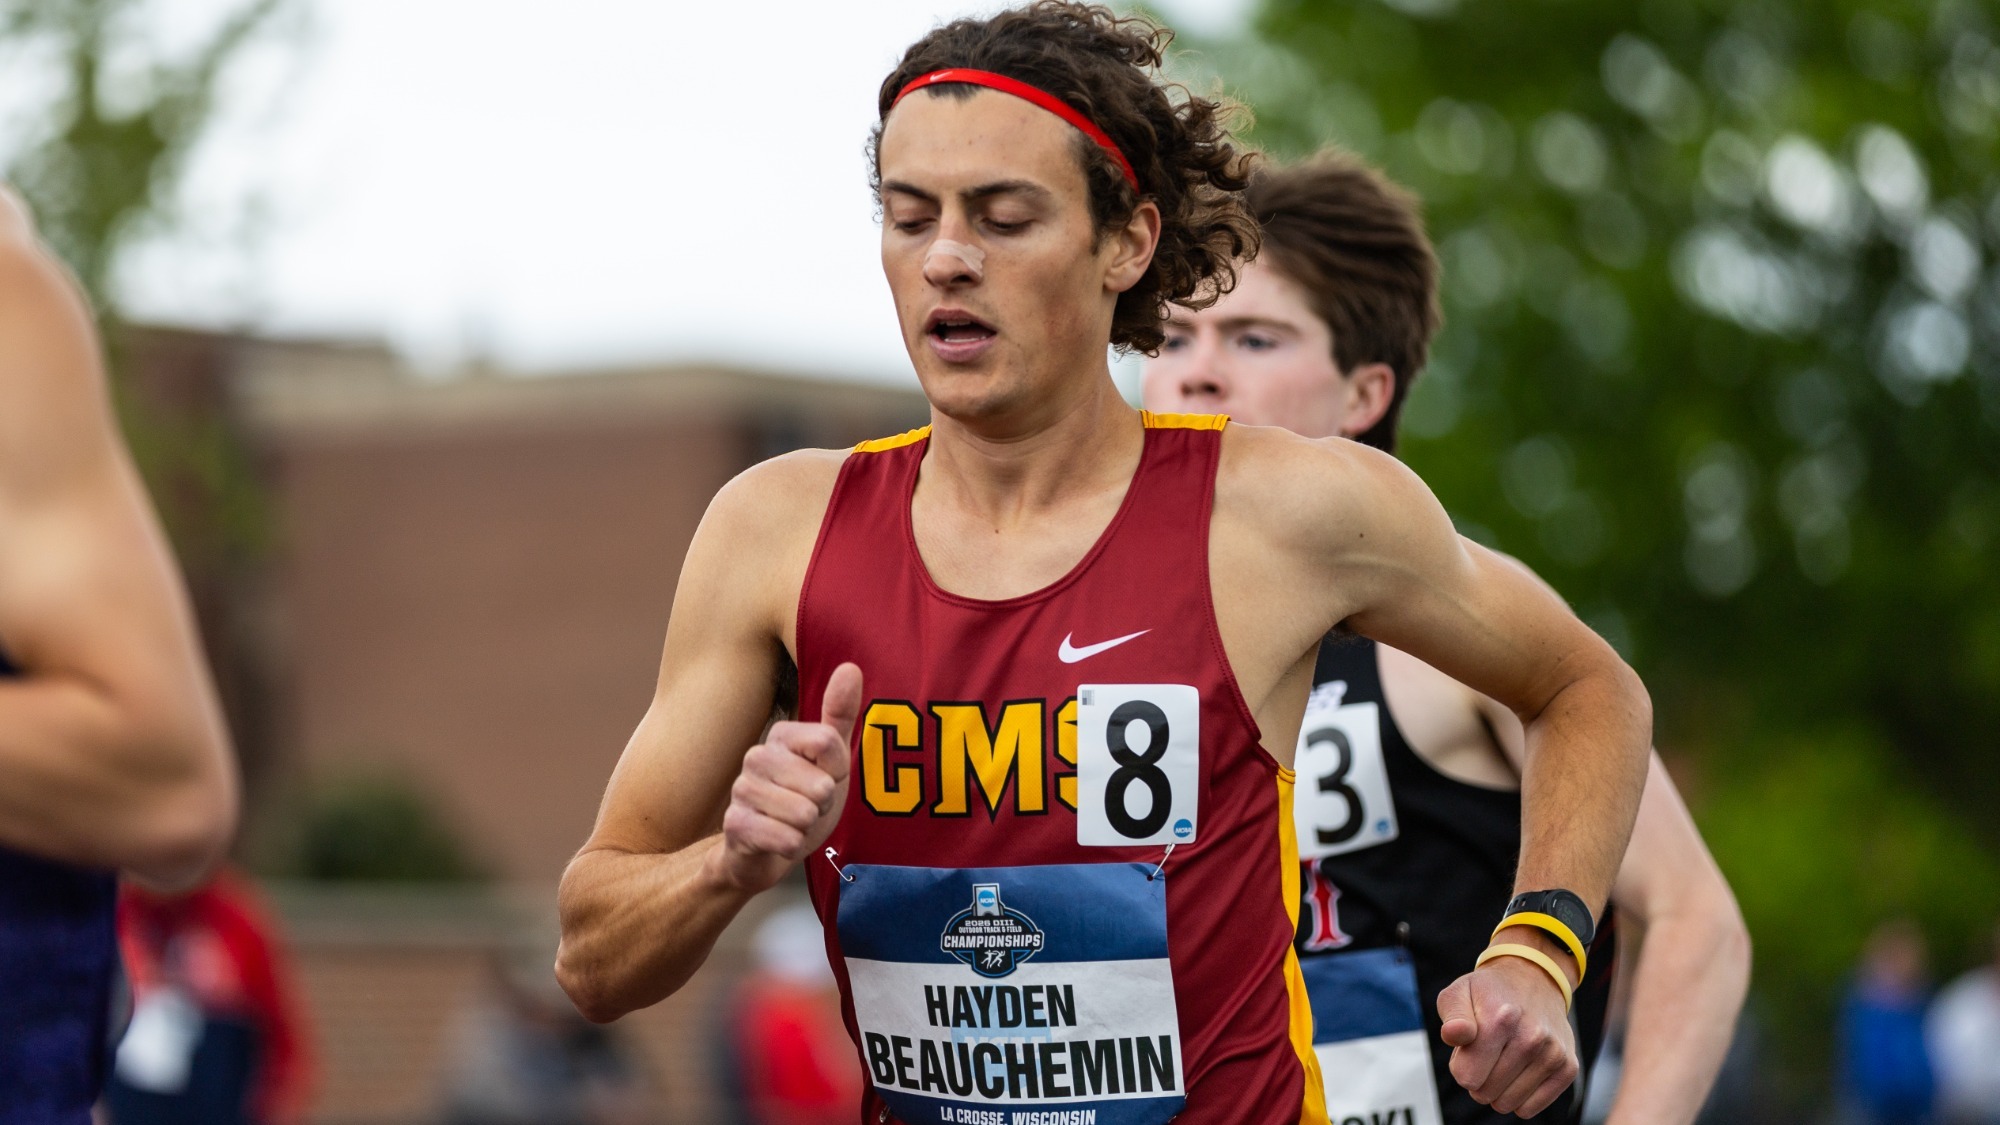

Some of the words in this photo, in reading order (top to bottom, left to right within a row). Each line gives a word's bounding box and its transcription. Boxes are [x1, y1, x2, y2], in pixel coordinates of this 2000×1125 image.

[1104, 700, 1172, 839] 8
[1306, 727, 1364, 844] 3
[943, 934, 1041, 948] CHAMPIONSHIPS
[958, 926, 983, 934] OUTDOOR
[1006, 925, 1022, 933] FIELD
[924, 984, 1077, 1028] HAYDEN
[864, 1031, 1176, 1099] BEAUCHEMIN
[940, 1106, 955, 1122] LA
[1011, 1109, 1096, 1125] WISCONSIN
